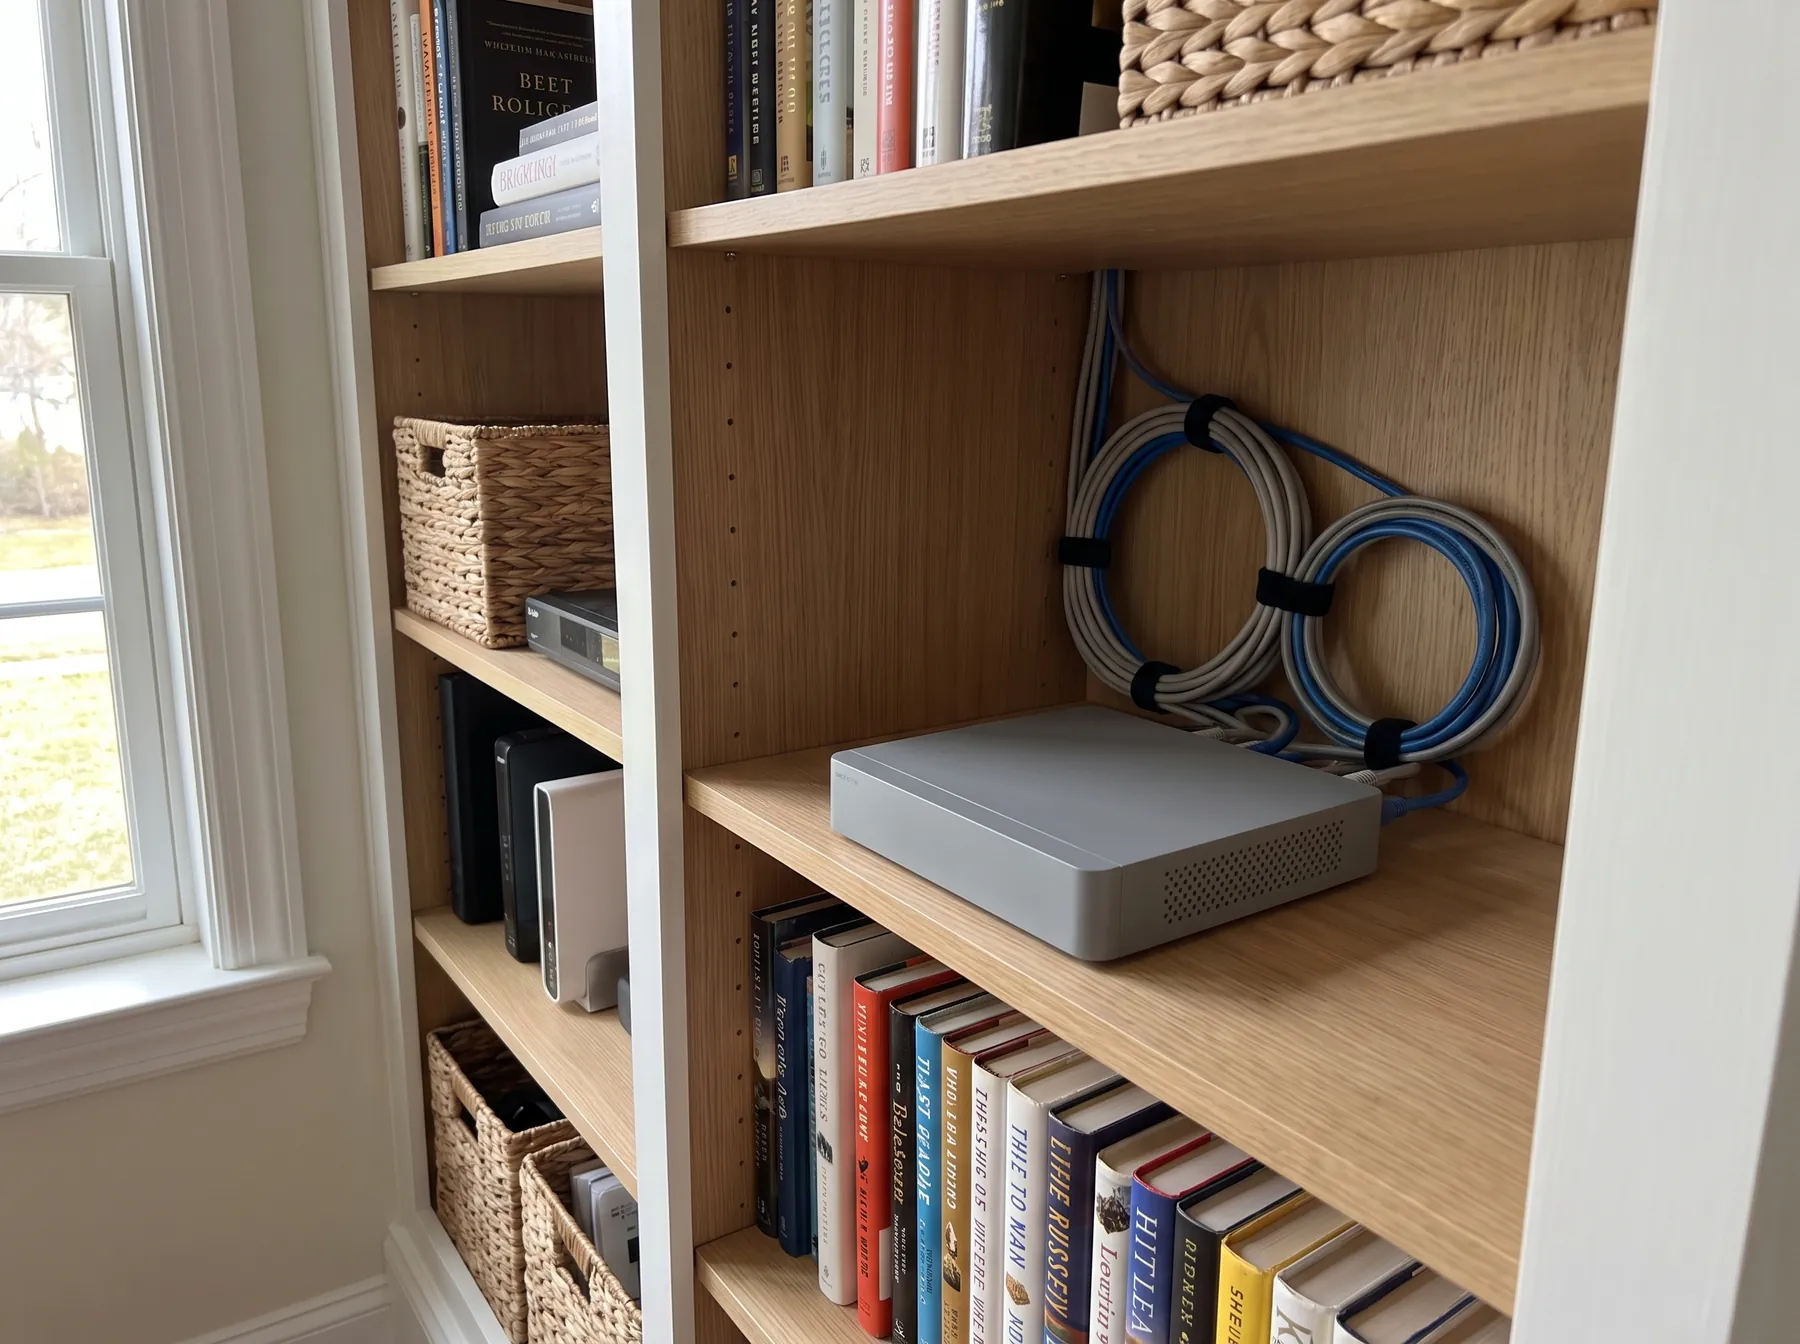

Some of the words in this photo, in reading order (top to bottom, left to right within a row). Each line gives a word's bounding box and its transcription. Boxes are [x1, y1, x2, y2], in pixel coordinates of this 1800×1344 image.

[519, 72, 573, 94] BEET
[1010, 1181, 1027, 1212] TO
[1009, 1215, 1026, 1271] WAN
